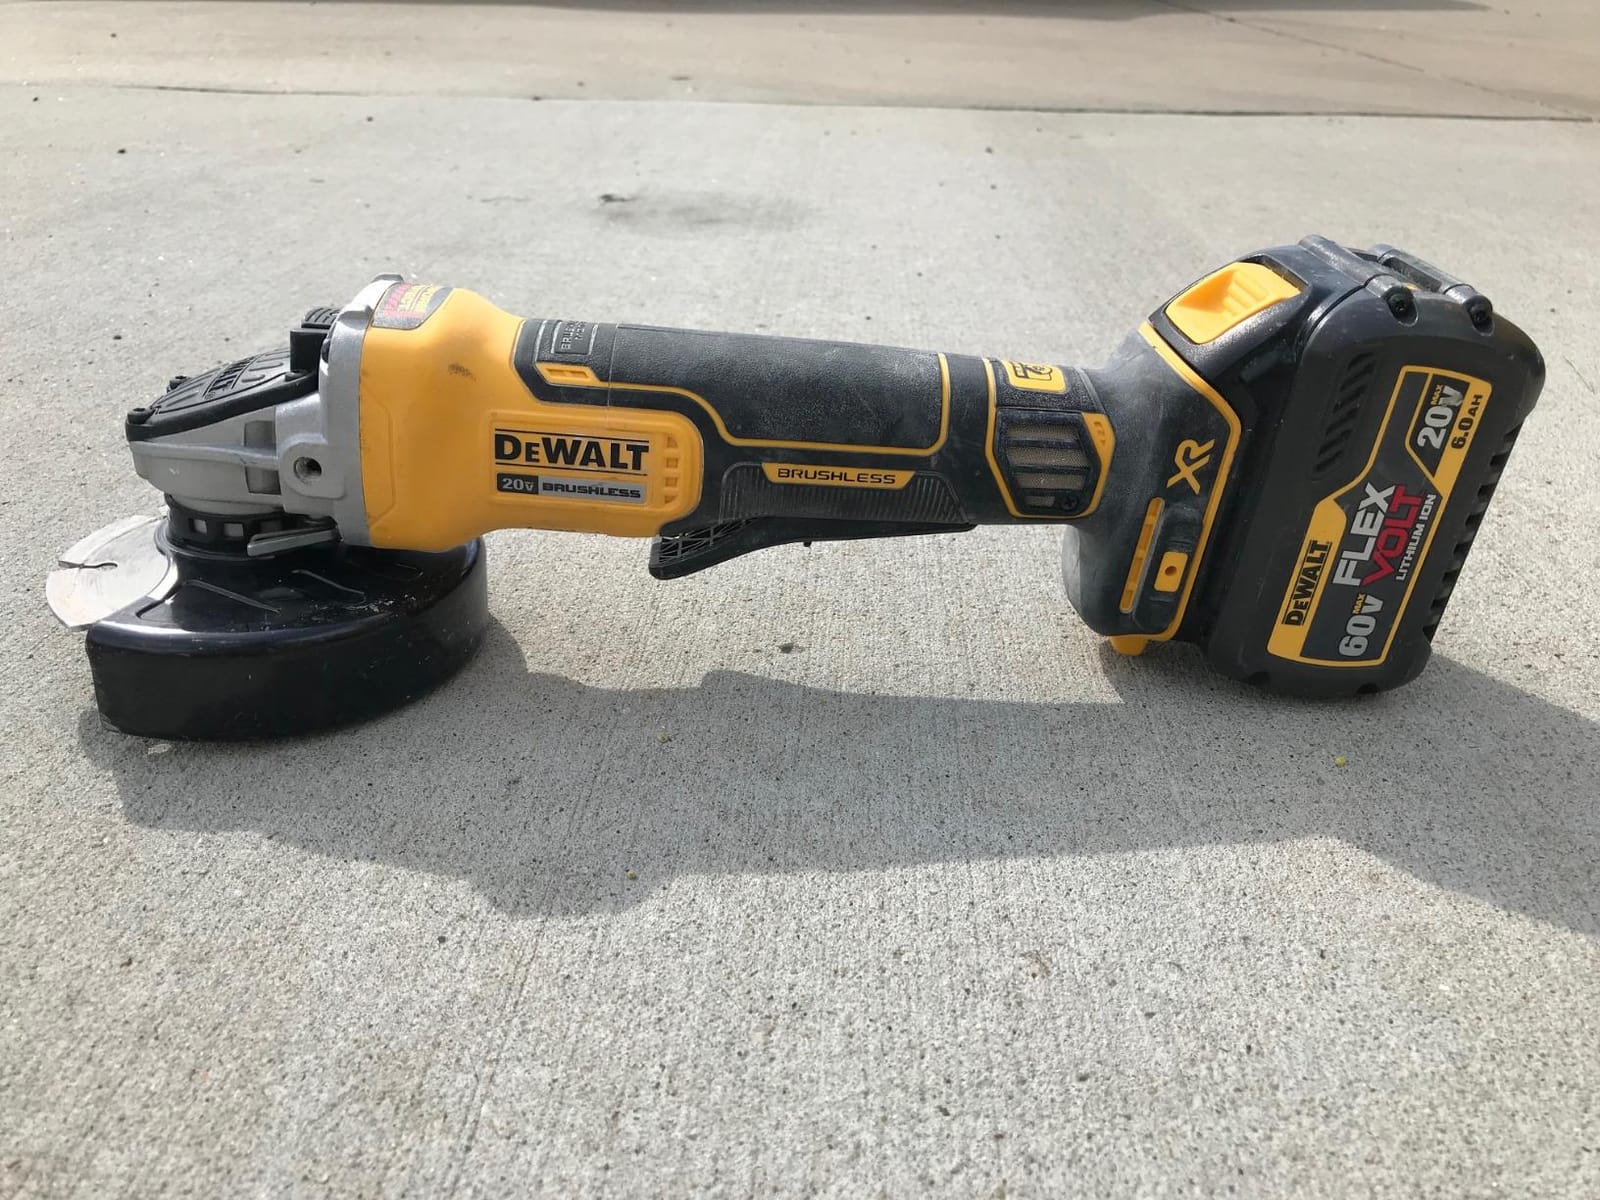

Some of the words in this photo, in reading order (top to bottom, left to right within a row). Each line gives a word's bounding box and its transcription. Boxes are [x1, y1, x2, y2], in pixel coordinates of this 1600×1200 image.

[1417, 385, 1464, 449] 20V
[1430, 384, 1443, 405] MAX
[542, 482, 641, 498] BRUSHLESS
[777, 468, 896, 484] BRUSHLESS
[1166, 439, 1215, 495] XR
[1333, 482, 1396, 586] FLEX
[1360, 485, 1424, 586] VOLT
[1395, 523, 1425, 581] LITHIUM
[1419, 494, 1437, 520] ION
[1338, 594, 1384, 657] 60V
[1353, 592, 1365, 614] MAX
